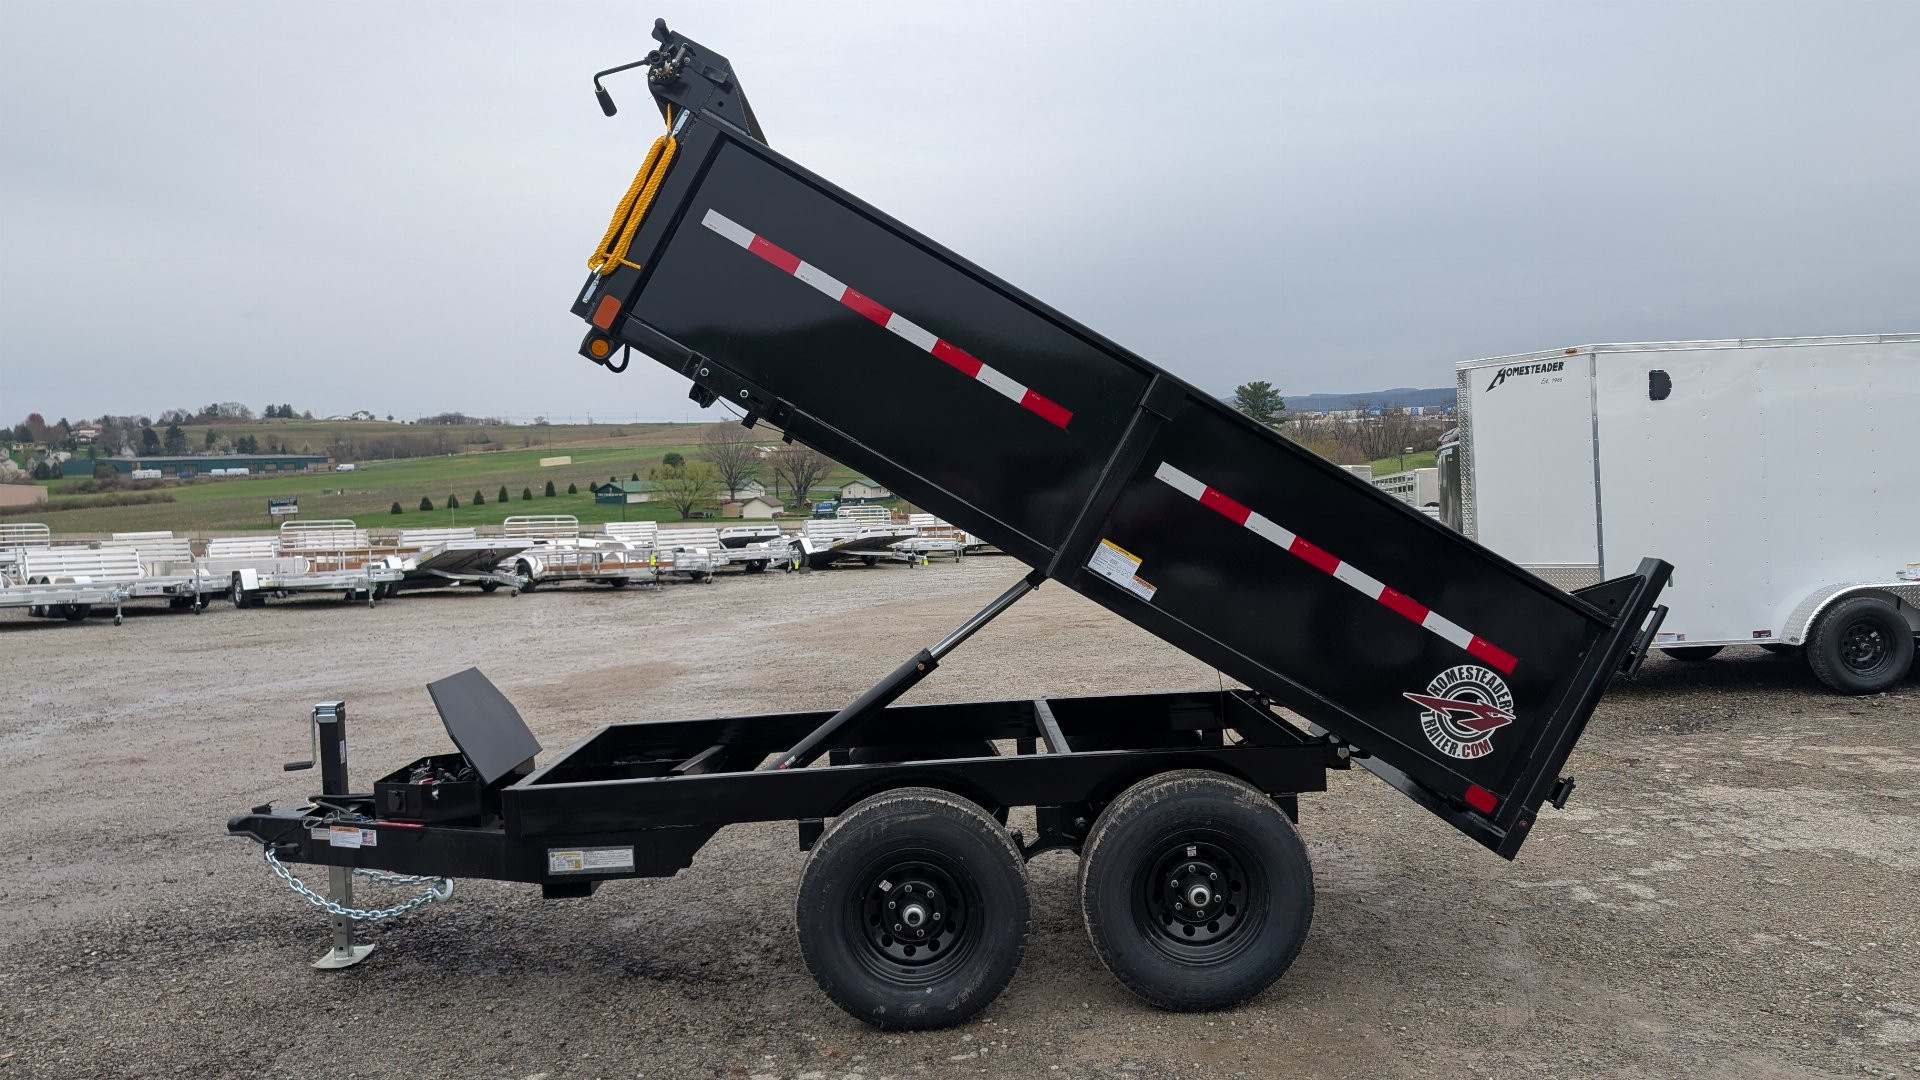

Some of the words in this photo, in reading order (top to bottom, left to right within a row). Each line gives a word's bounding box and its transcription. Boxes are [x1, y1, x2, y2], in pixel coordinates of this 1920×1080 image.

[1485, 362, 1564, 393] HOMESTEADER
[1428, 666, 1512, 710] HOMESTEADER
[1421, 711, 1491, 758] TRAILER.COM
